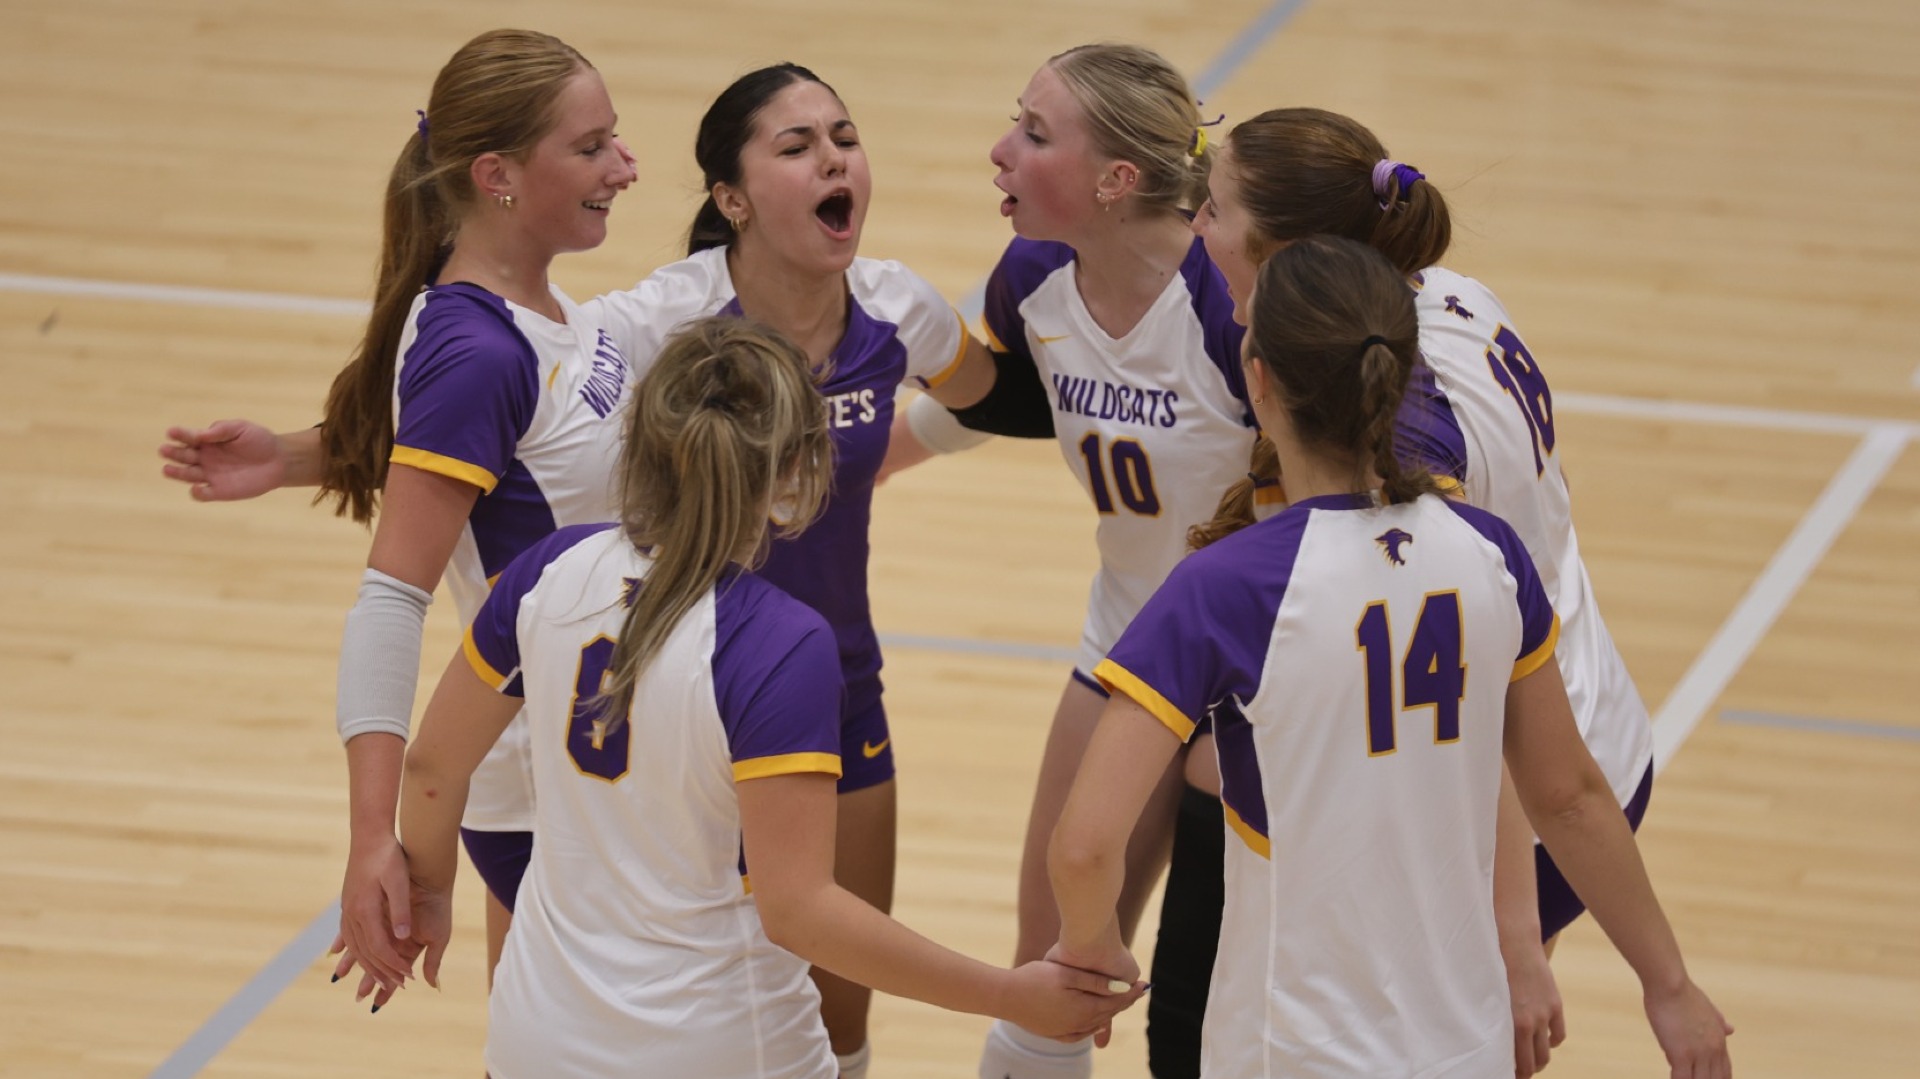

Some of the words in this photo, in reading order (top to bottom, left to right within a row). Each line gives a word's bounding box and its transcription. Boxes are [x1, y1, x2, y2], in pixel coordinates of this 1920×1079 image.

[1053, 373, 1179, 428] WILDCATS
[1484, 322, 1555, 481] 18
[1079, 430, 1163, 519] 10
[1354, 588, 1468, 758] 14
